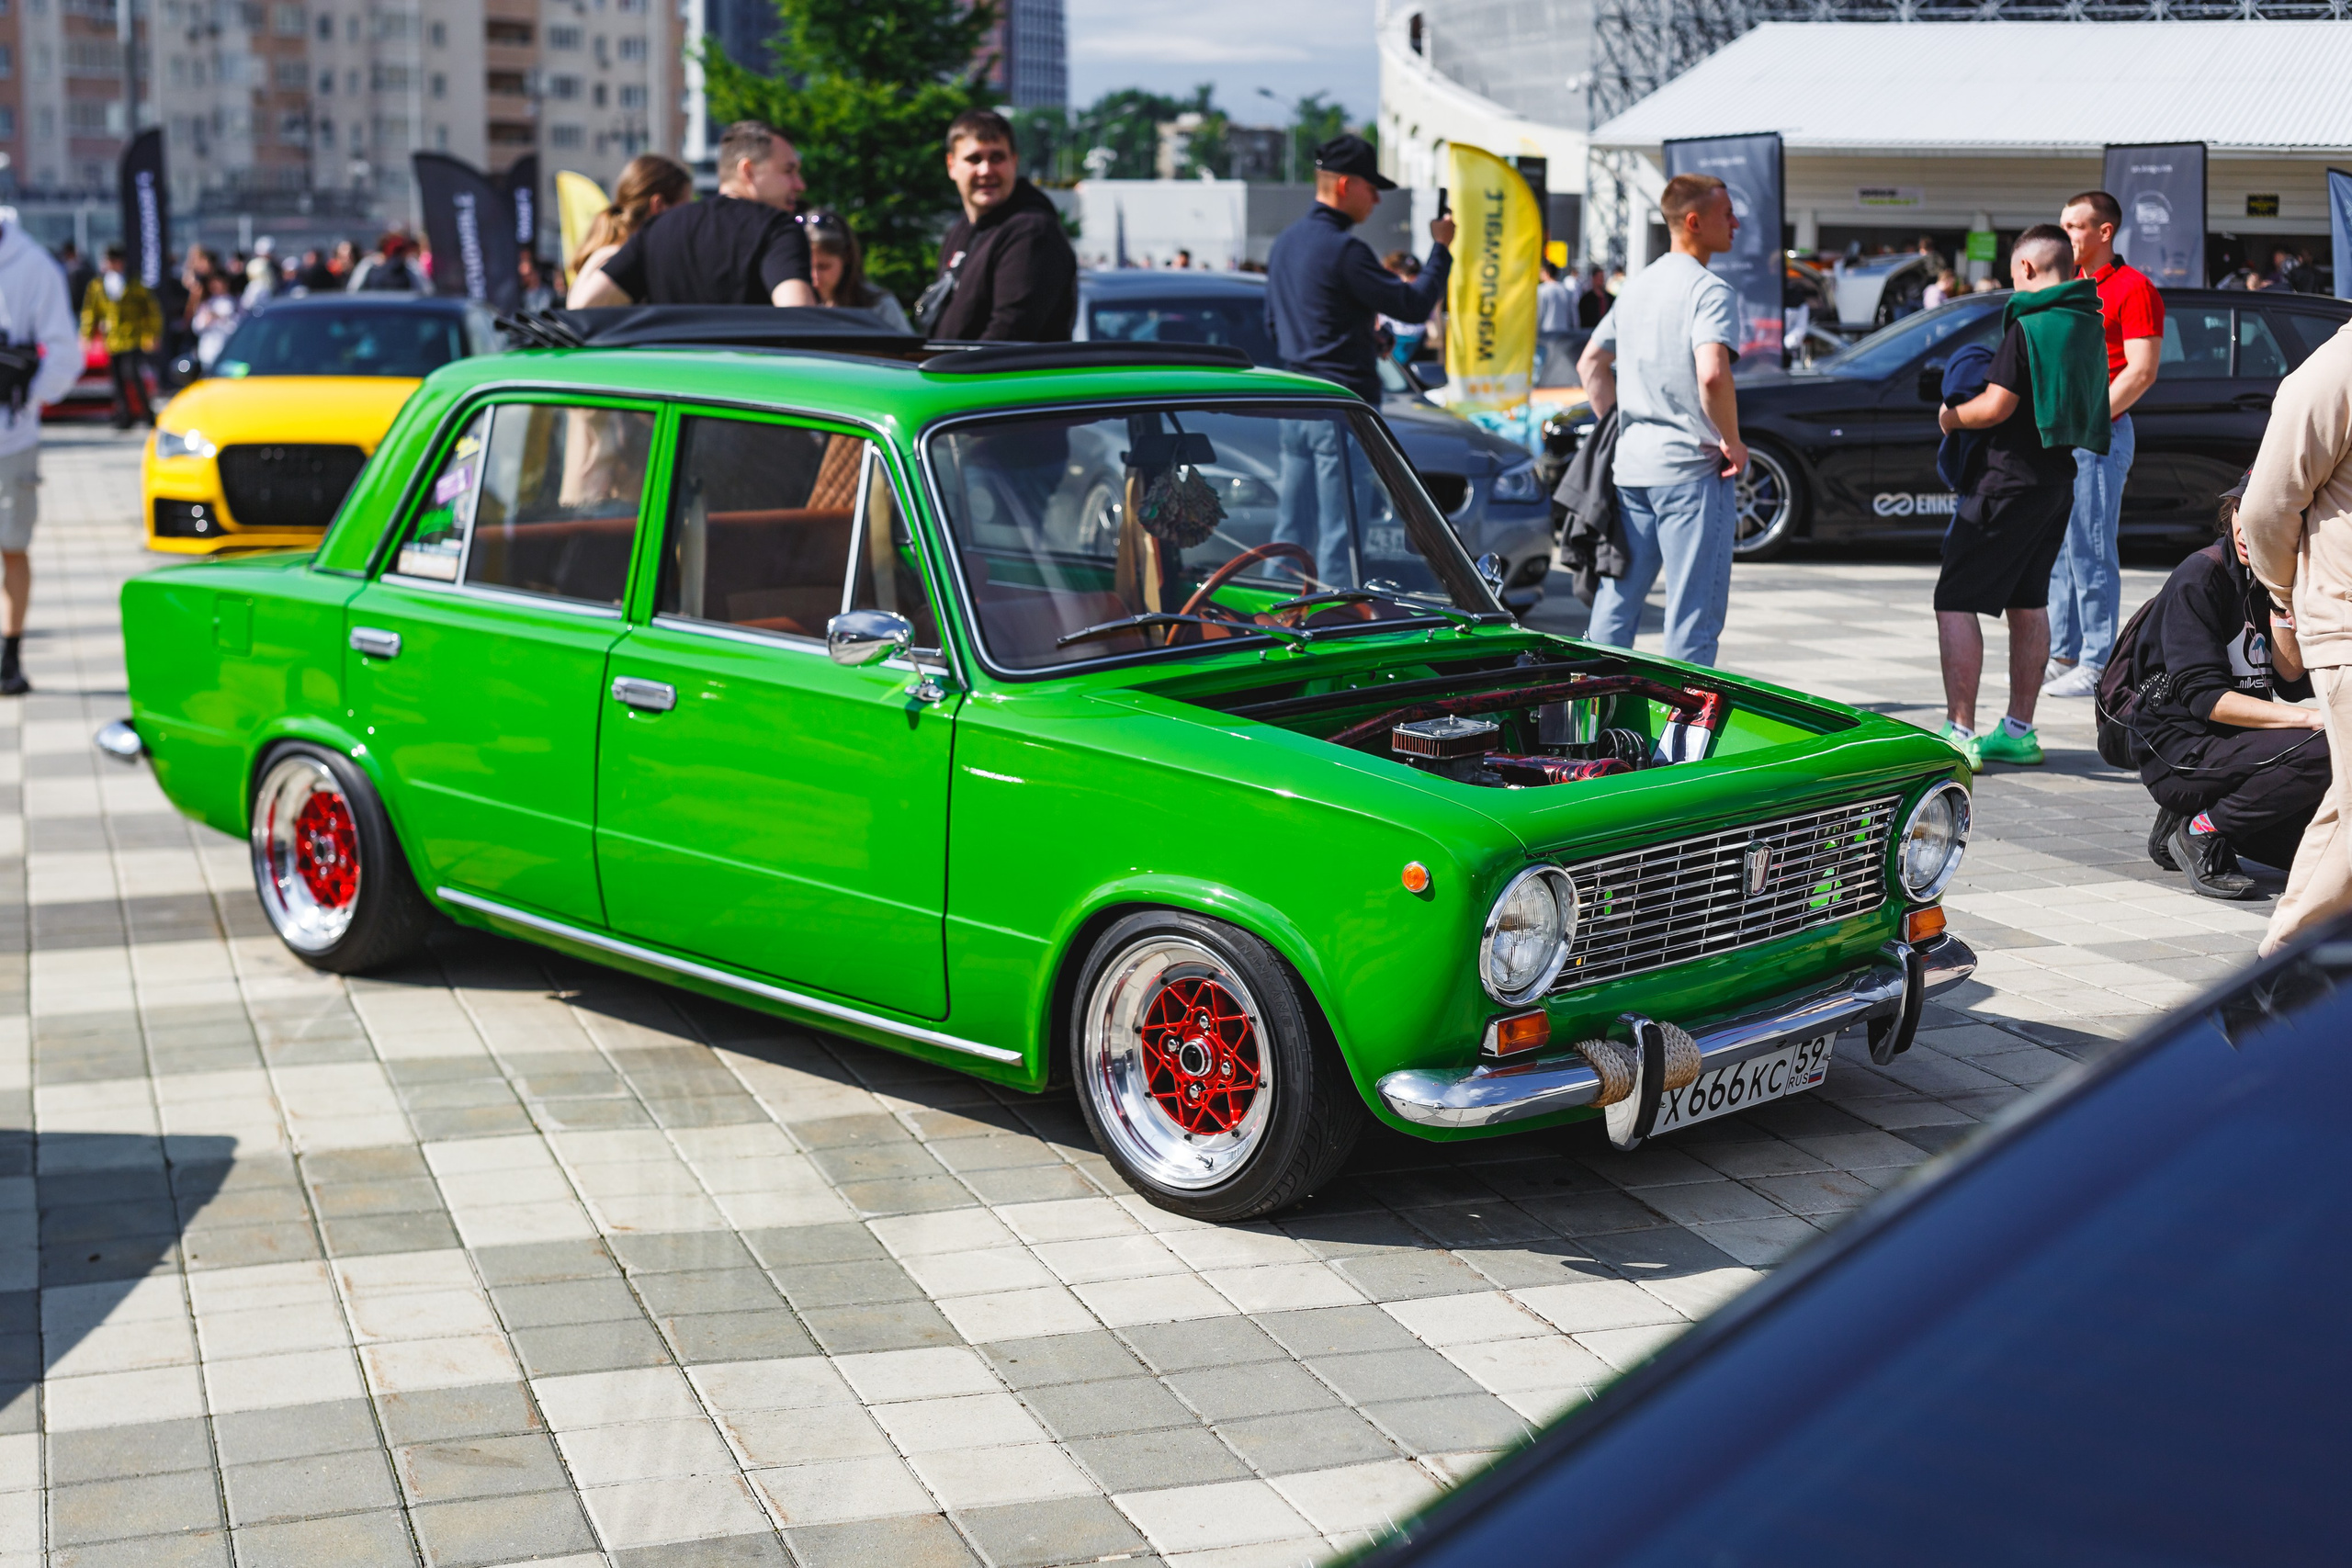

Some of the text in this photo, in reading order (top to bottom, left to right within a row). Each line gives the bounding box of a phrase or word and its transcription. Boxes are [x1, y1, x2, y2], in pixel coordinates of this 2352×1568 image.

[1916, 493, 1959, 514] ENKE
[1240, 942, 1294, 1029] NANKANG
[1795, 1036, 1826, 1074] 59
[1787, 1072, 1809, 1089] RUS
